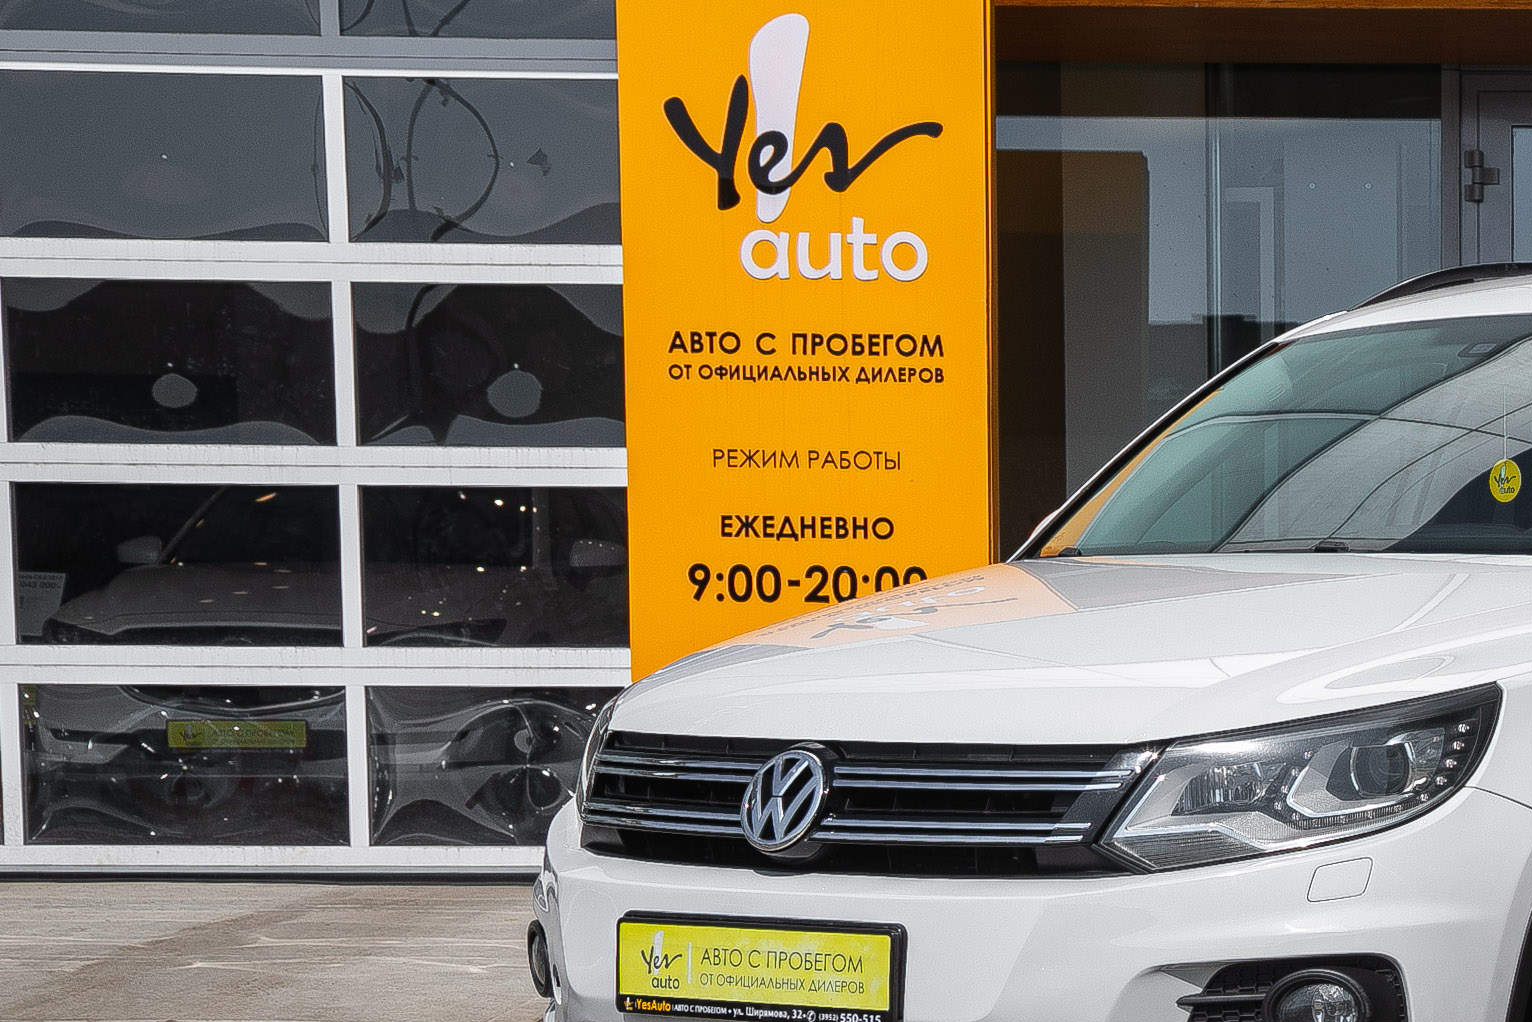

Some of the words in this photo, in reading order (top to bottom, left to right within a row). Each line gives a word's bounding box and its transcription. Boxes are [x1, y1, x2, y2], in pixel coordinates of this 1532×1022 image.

[739, 216, 929, 282] auto
[668, 331, 741, 355] АВТО
[755, 333, 777, 356] С
[791, 333, 945, 358] ПРОБЕГОМ
[668, 364, 692, 380] ОТ
[698, 364, 850, 384] ОФИЦИАЛЬНЫХ
[855, 366, 945, 384] ДИЛЕРОВ
[712, 448, 799, 469] РЕЖИМ
[808, 450, 901, 470] РАБОТЫ
[720, 515, 895, 541] ЕЖЕДНЕВНО
[700, 948, 743, 968] АВТО
[748, 950, 761, 968] С
[766, 951, 863, 973] ПРОБЕГОМ
[651, 975, 680, 990] auto
[700, 973, 714, 986] ОТ
[716, 974, 805, 992] ОФИЦИАЛЬНЫХ
[808, 980, 865, 994] ДИЛЕРОВ
[636, 998, 671, 1012] YesAuto
